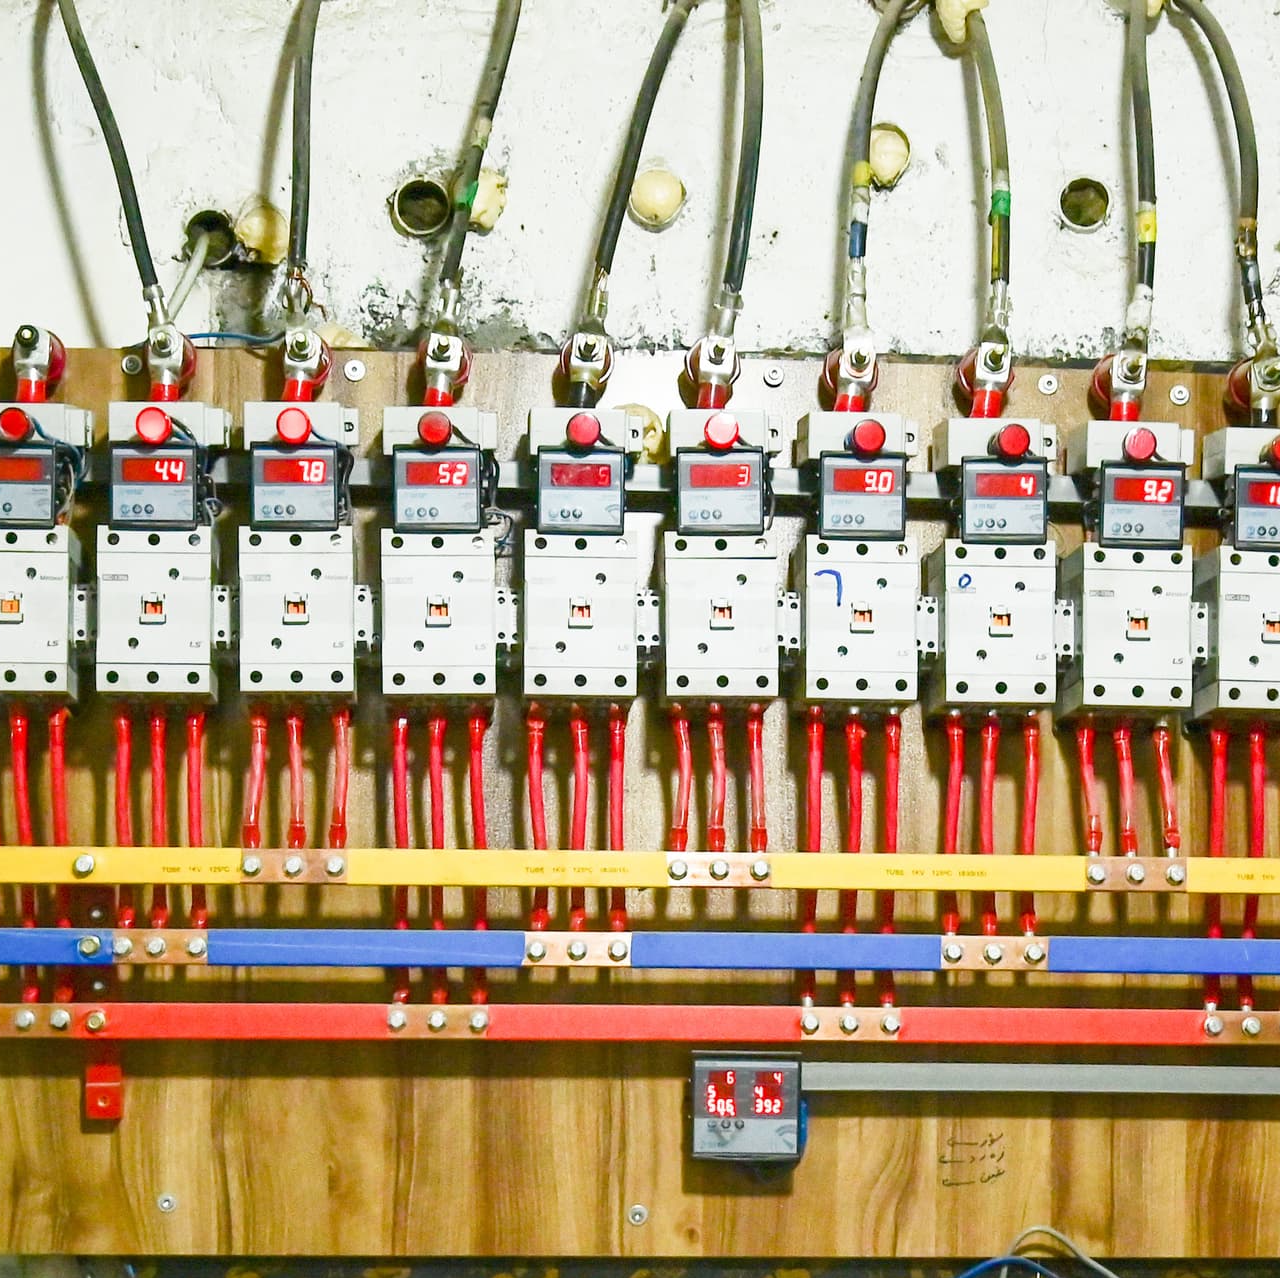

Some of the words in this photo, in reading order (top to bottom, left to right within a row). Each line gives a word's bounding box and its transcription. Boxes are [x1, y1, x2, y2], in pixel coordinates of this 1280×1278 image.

[738, 466, 749, 486] 3
[1020, 476, 1034, 496] 4
[47, 640, 59, 648] LS
[1172, 657, 1184, 665] LS
[726, 1071, 734, 1085] 6
[773, 1072, 782, 1084] 4
[754, 1086, 764, 1098] 4
[755, 1099, 782, 1114] 392
